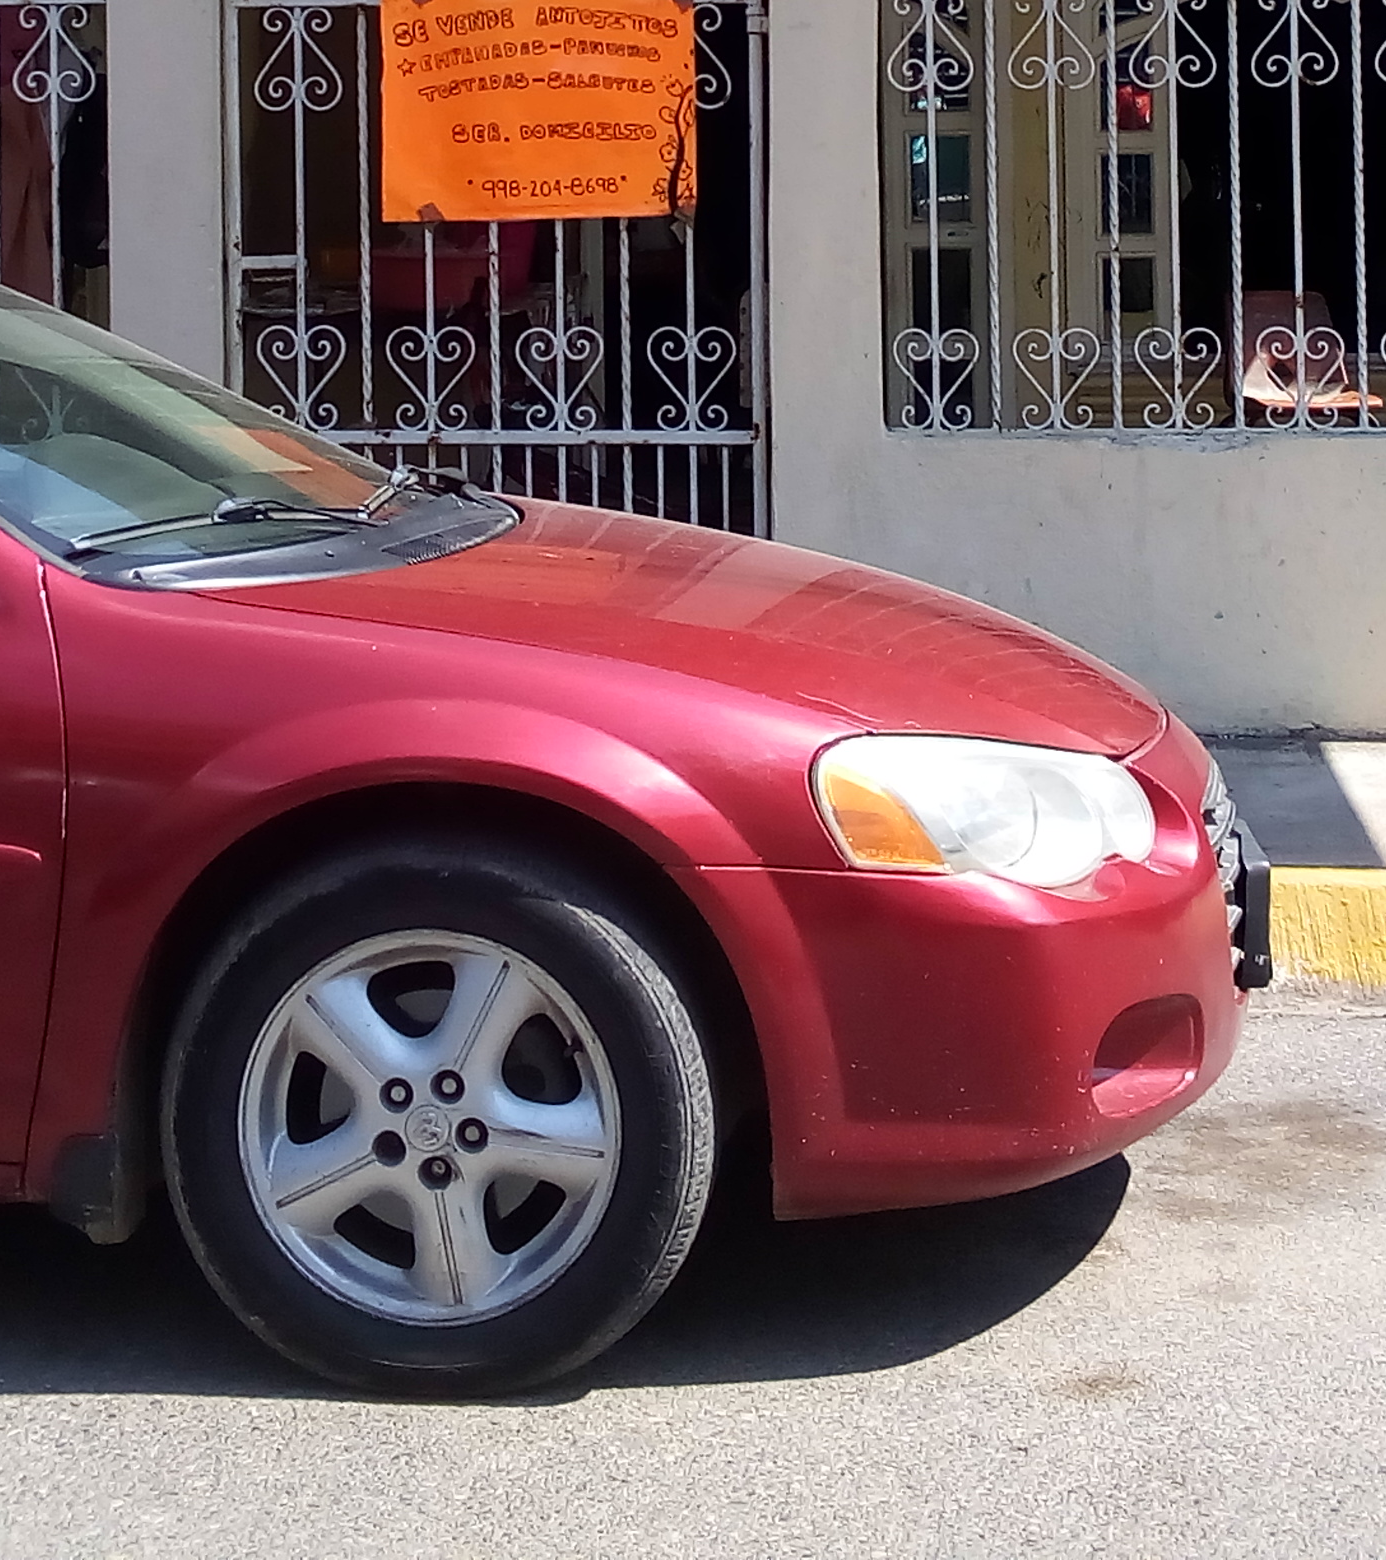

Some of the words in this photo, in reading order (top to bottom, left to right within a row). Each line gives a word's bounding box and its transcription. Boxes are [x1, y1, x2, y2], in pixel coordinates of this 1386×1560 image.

[392, 19, 430, 47] SE
[435, 7, 515, 37] VENDE
[535, 6, 679, 38] ANTOJITOS
[451, 121, 511, 144] SER.
[519, 121, 657, 141] DOMICILIO
